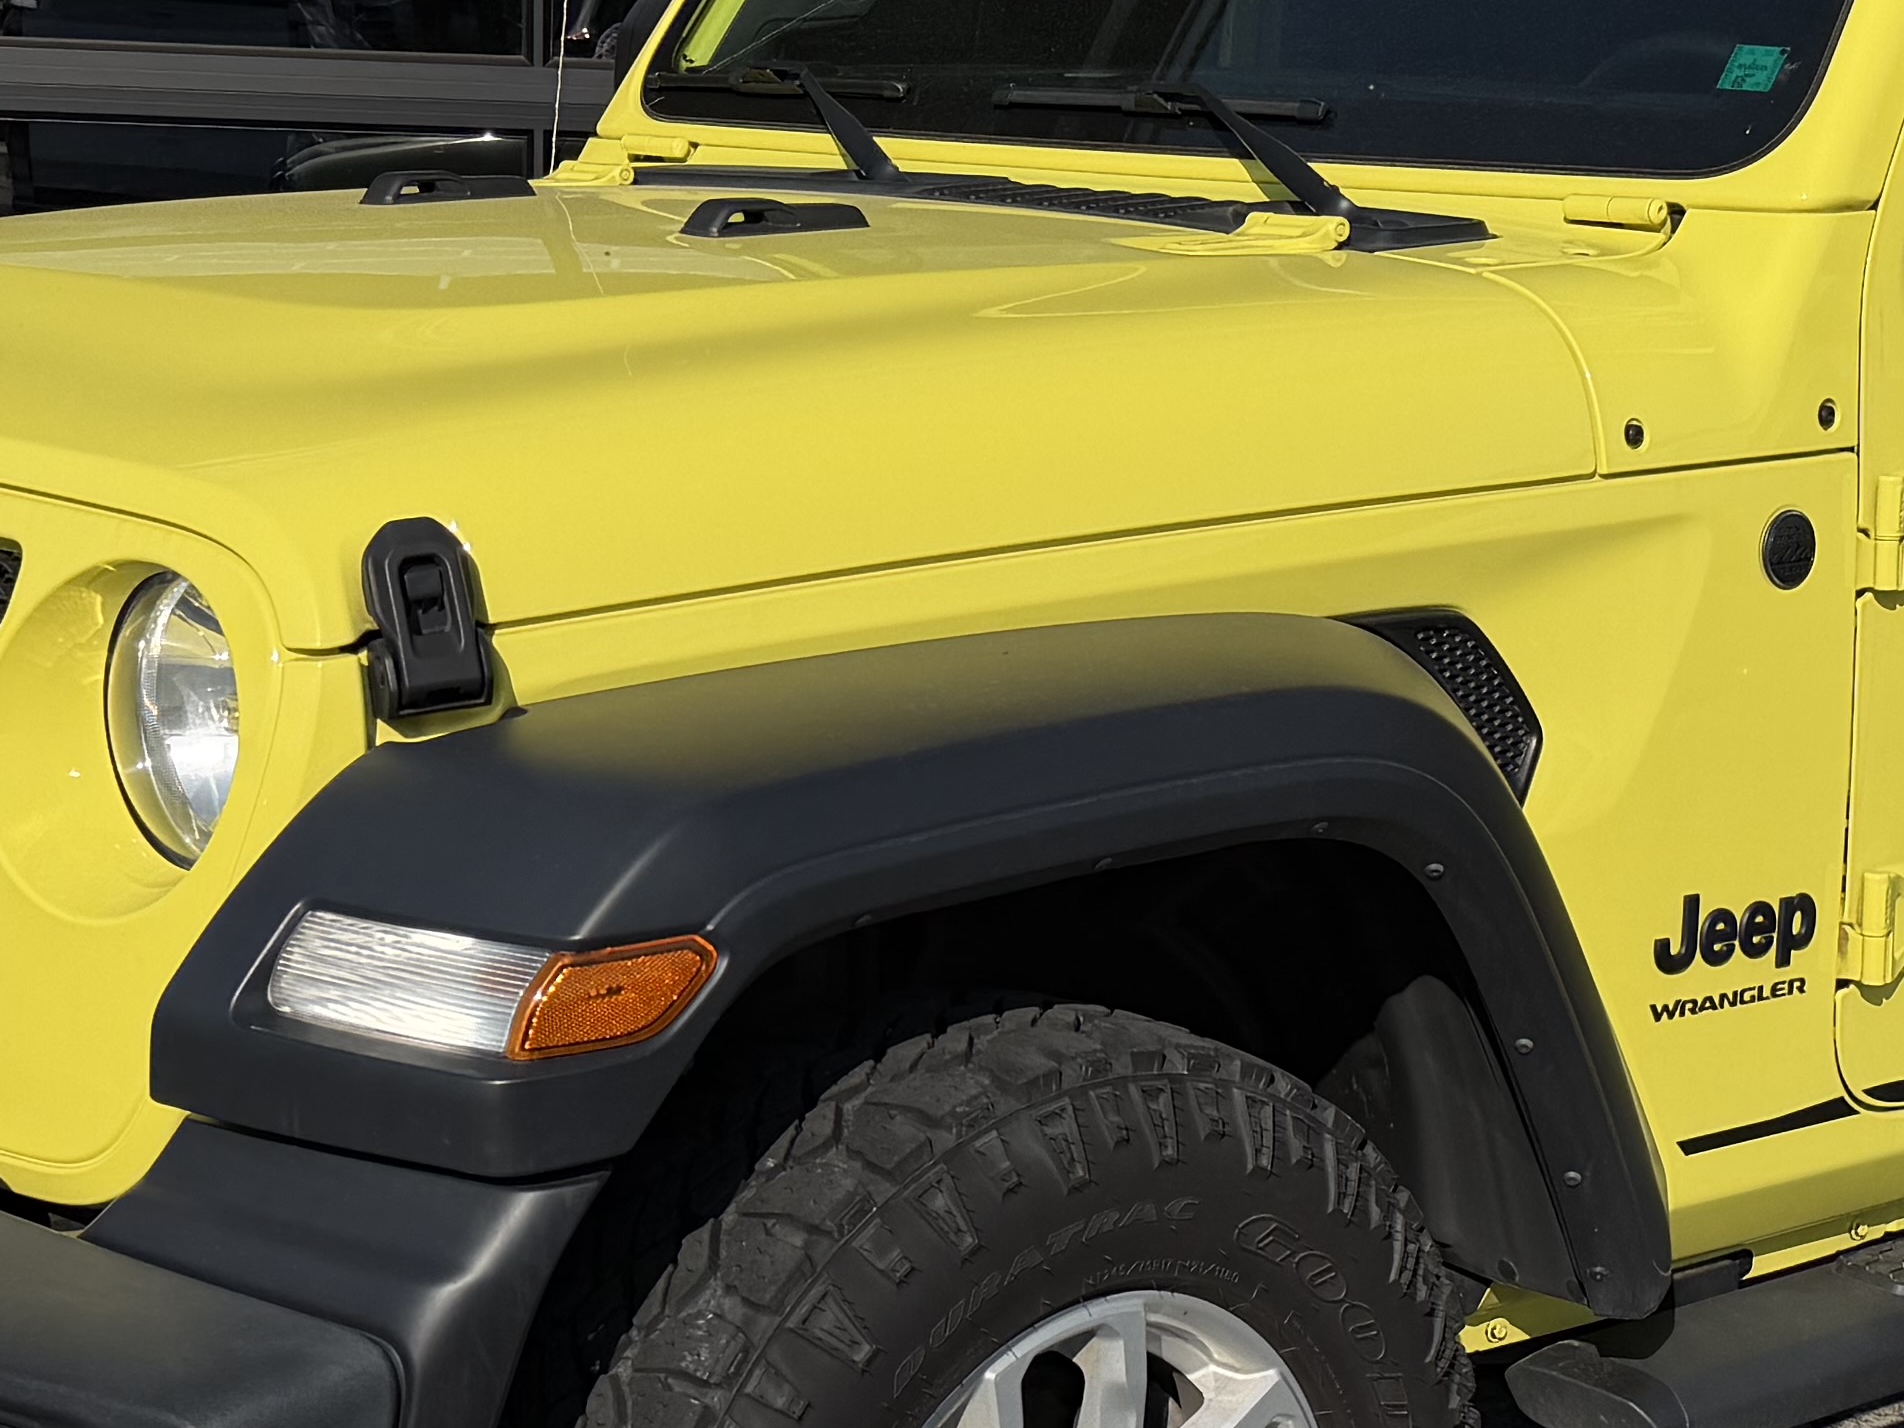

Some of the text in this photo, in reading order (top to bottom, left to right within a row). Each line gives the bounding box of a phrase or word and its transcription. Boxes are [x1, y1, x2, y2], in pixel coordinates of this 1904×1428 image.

[1653, 892, 1817, 976] Jeep
[1649, 976, 1807, 1023] WRANGLER
[893, 1195, 1201, 1400] DURATRAC
